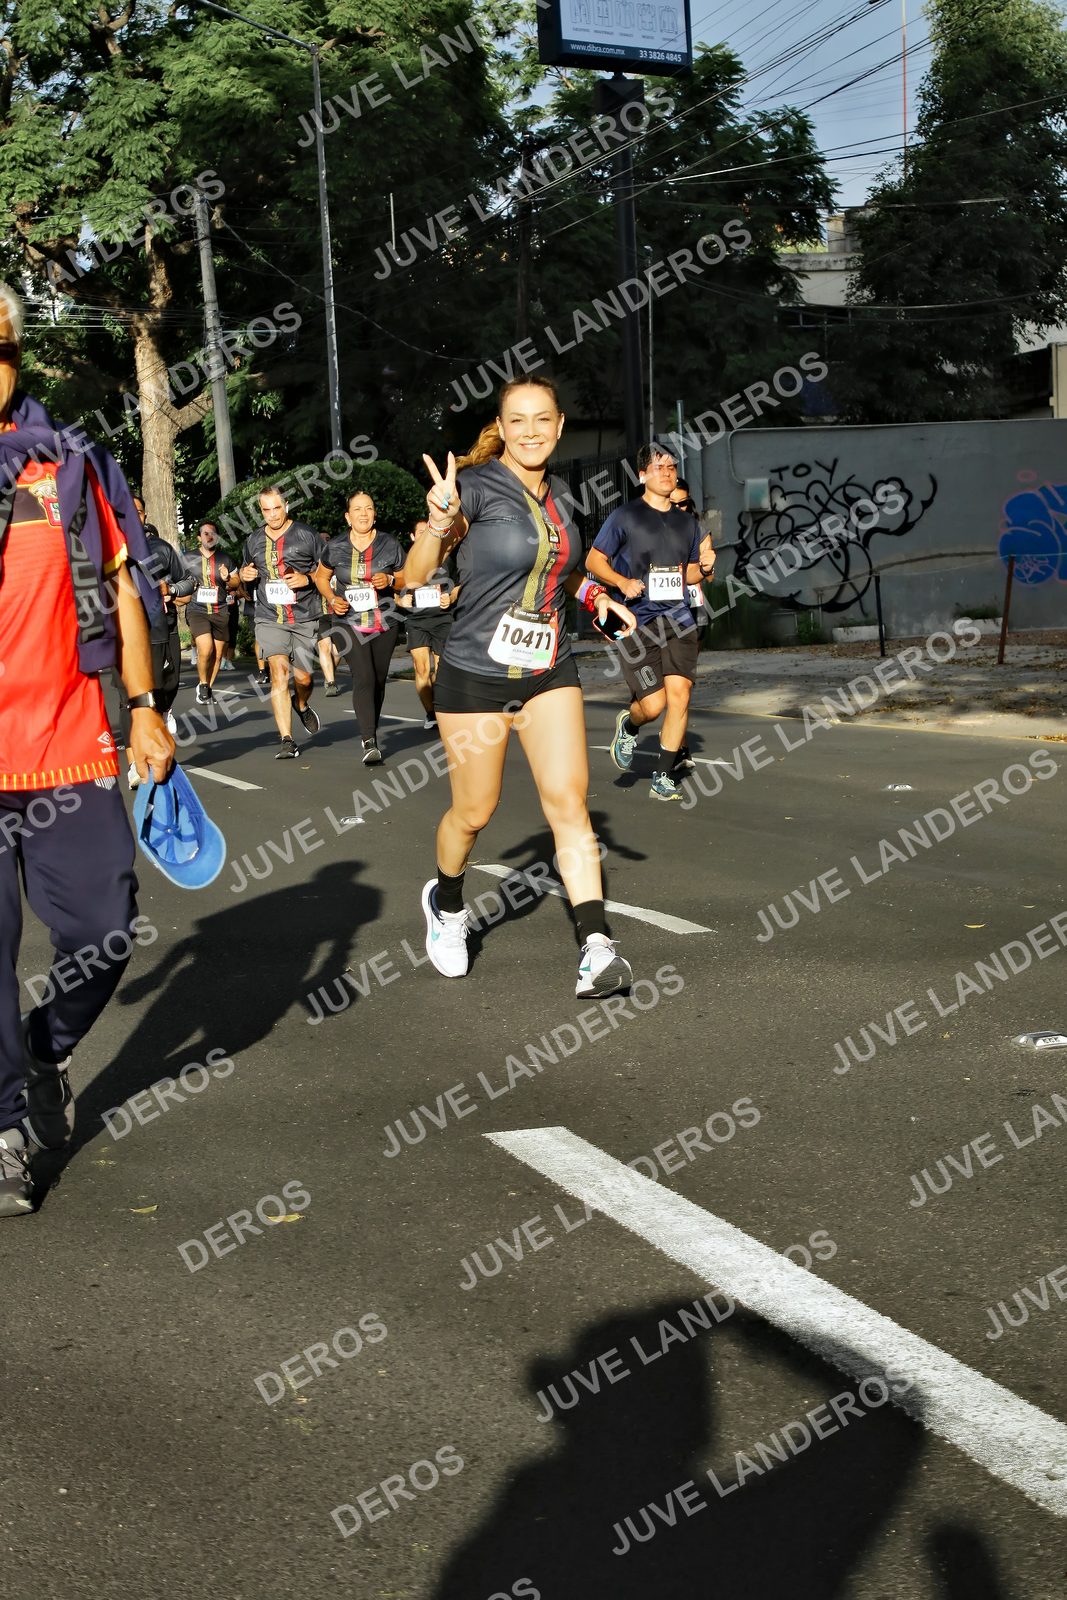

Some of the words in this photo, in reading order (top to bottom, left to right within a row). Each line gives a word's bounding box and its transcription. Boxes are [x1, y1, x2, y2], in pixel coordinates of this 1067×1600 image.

[570, 42, 626, 56] www.dibra.com.mx
[639, 49, 648, 59] 33
[649, 51, 665, 60] 3826
[665, 53, 682, 62] 4845
[769, 457, 839, 485] TOY
[652, 576, 682, 588] 12168
[348, 591, 371, 603] 9699
[501, 623, 551, 651] 10411
[634, 665, 658, 690] 10
